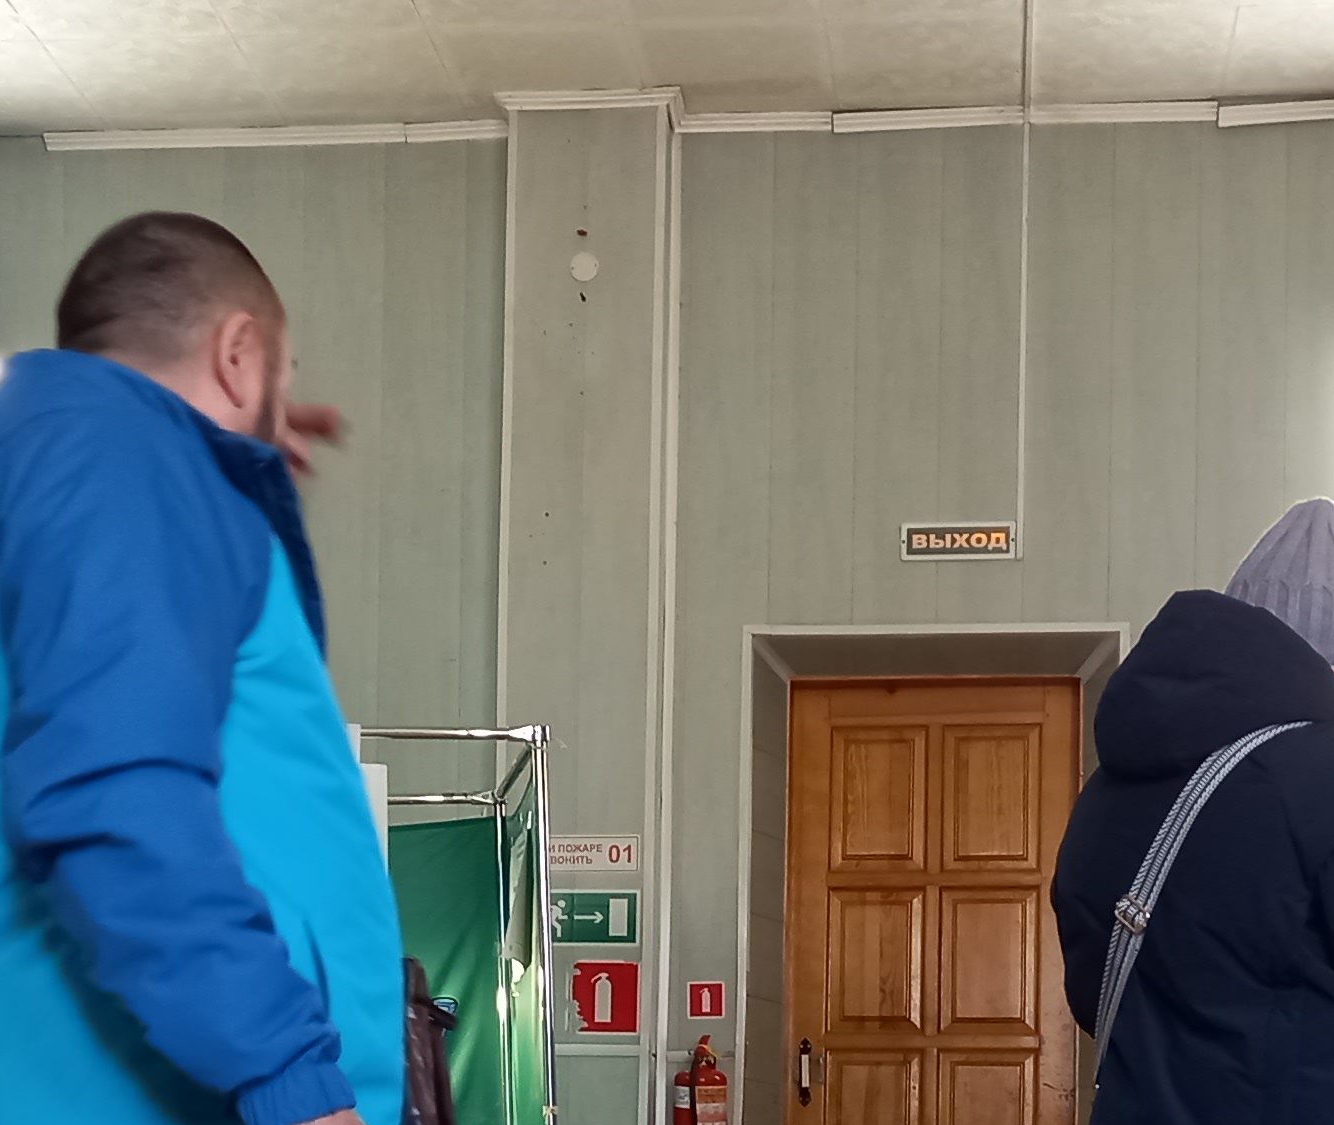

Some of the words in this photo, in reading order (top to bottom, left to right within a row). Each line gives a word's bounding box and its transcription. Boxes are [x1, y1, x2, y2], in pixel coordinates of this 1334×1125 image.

[912, 532, 1007, 550] ВЫХОД
[557, 843, 603, 854] ПОЖАРЕ
[608, 843, 633, 864] 01
[549, 855, 593, 865] ВОНИТЬ
